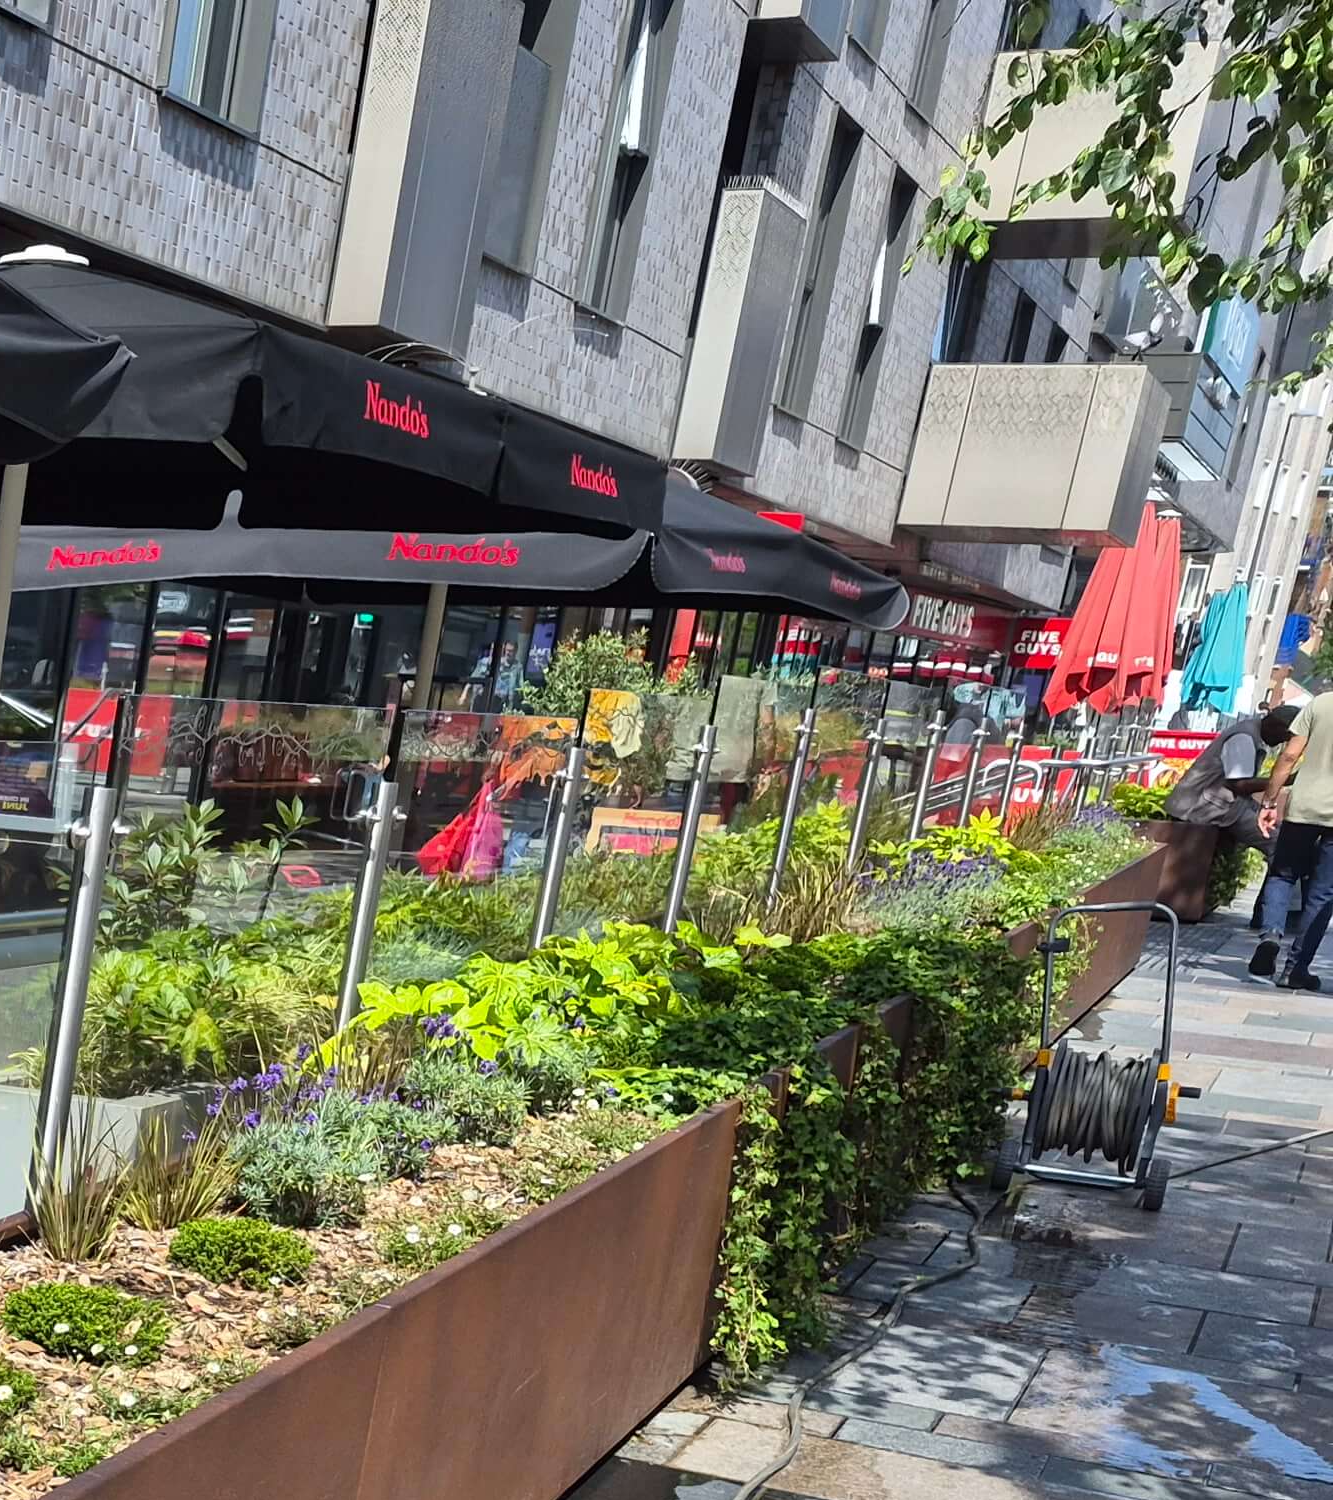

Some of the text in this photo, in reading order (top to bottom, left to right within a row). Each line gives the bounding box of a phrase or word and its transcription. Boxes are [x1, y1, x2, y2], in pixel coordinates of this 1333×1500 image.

[363, 379, 429, 438] Nando's
[571, 453, 619, 497] Nando's
[45, 537, 162, 571] Nando's
[386, 532, 519, 567] Nando's
[912, 594, 975, 638] FIVE GUYS
[1014, 642, 1062, 656] GUYS
[1020, 630, 1061, 643] FIVE
[1149, 737, 1176, 749] FIVE
